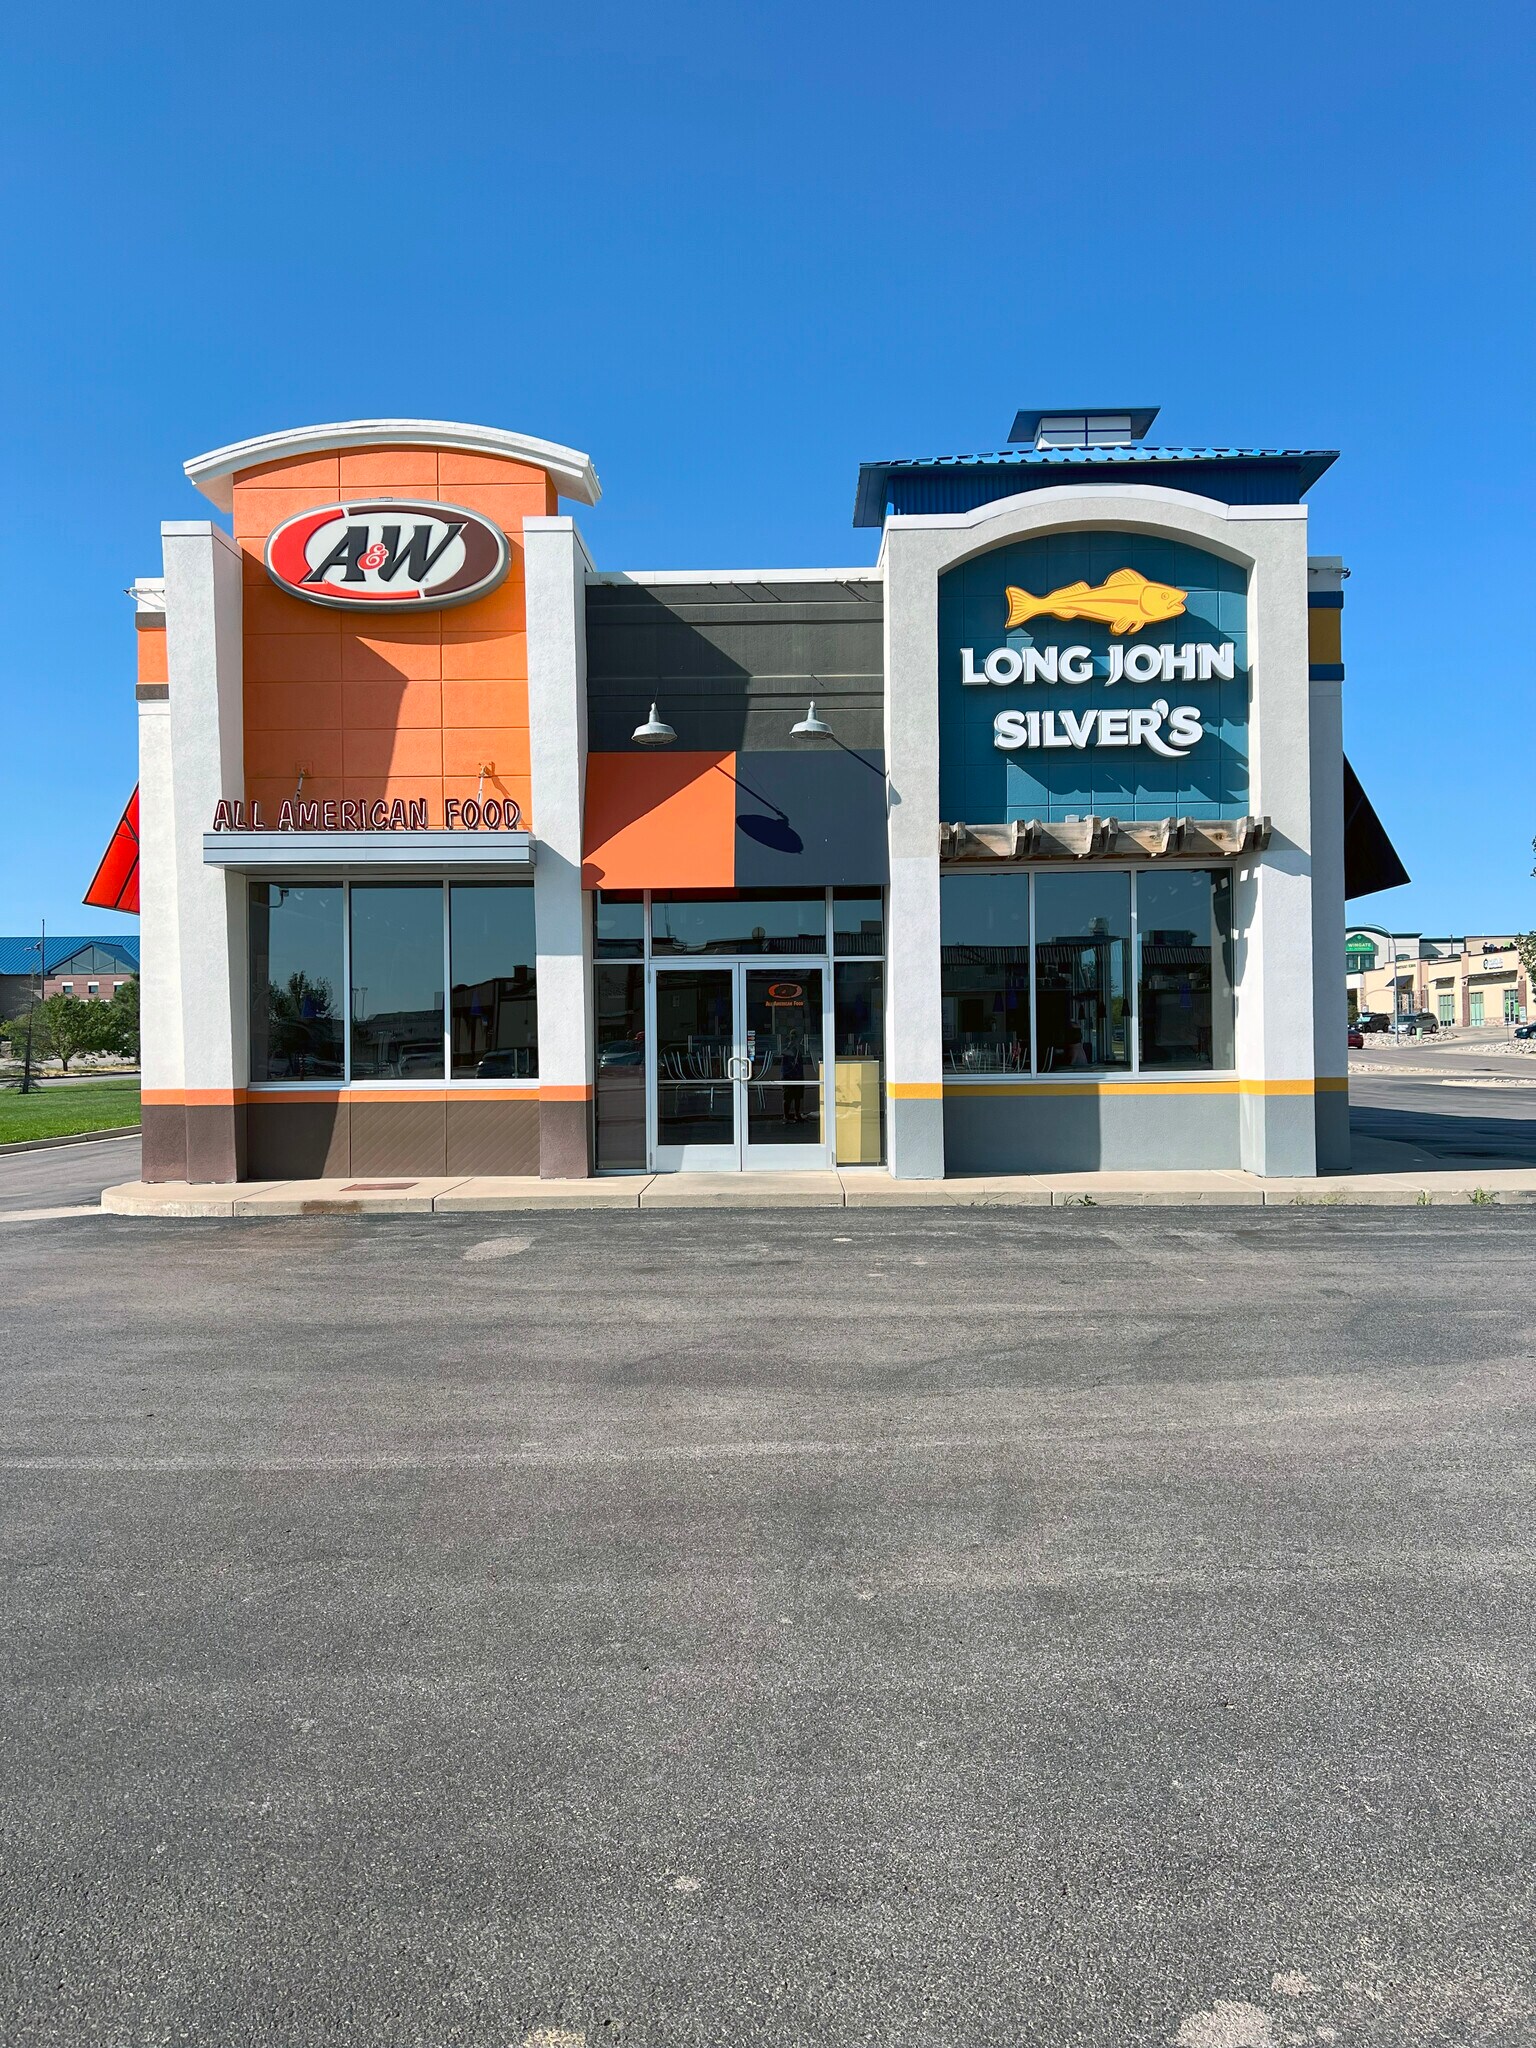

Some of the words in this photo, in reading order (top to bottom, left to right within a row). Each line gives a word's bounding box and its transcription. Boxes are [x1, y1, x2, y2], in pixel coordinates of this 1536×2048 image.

[300, 521, 468, 583] A&W
[960, 645, 1093, 686] LONG
[1104, 642, 1235, 687] JOHN
[993, 699, 1203, 758] SILVER'S
[213, 799, 265, 831] ALL
[278, 798, 429, 830] AMERICAN
[444, 798, 522, 830] FOOD
